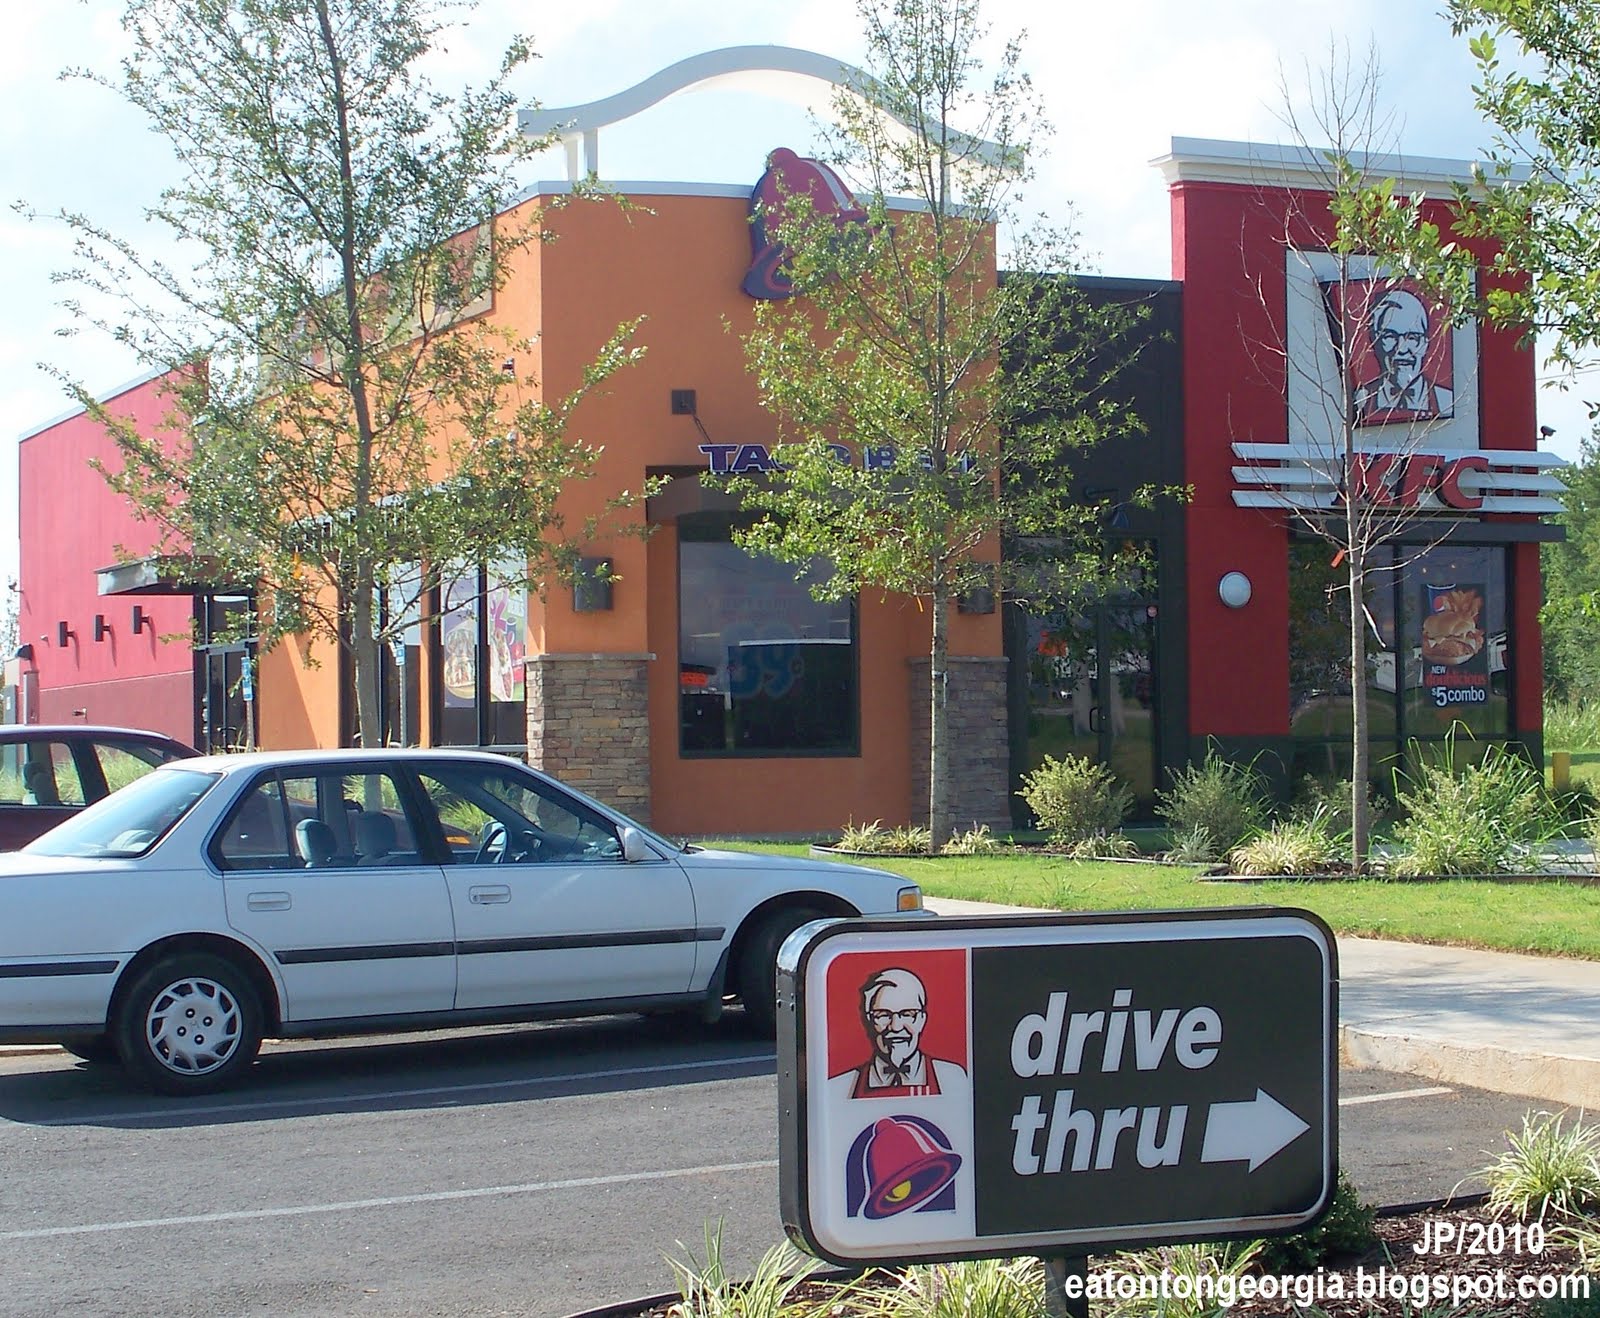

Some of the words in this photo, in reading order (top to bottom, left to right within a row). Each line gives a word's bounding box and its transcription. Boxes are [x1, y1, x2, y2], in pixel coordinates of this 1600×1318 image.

[1331, 452, 1489, 509] KFC
[1431, 665, 1447, 675] NEW
[1431, 686, 1448, 707] $5
[1447, 685, 1485, 702] combo
[1009, 988, 1224, 1078] drive
[1010, 1087, 1189, 1176] thru
